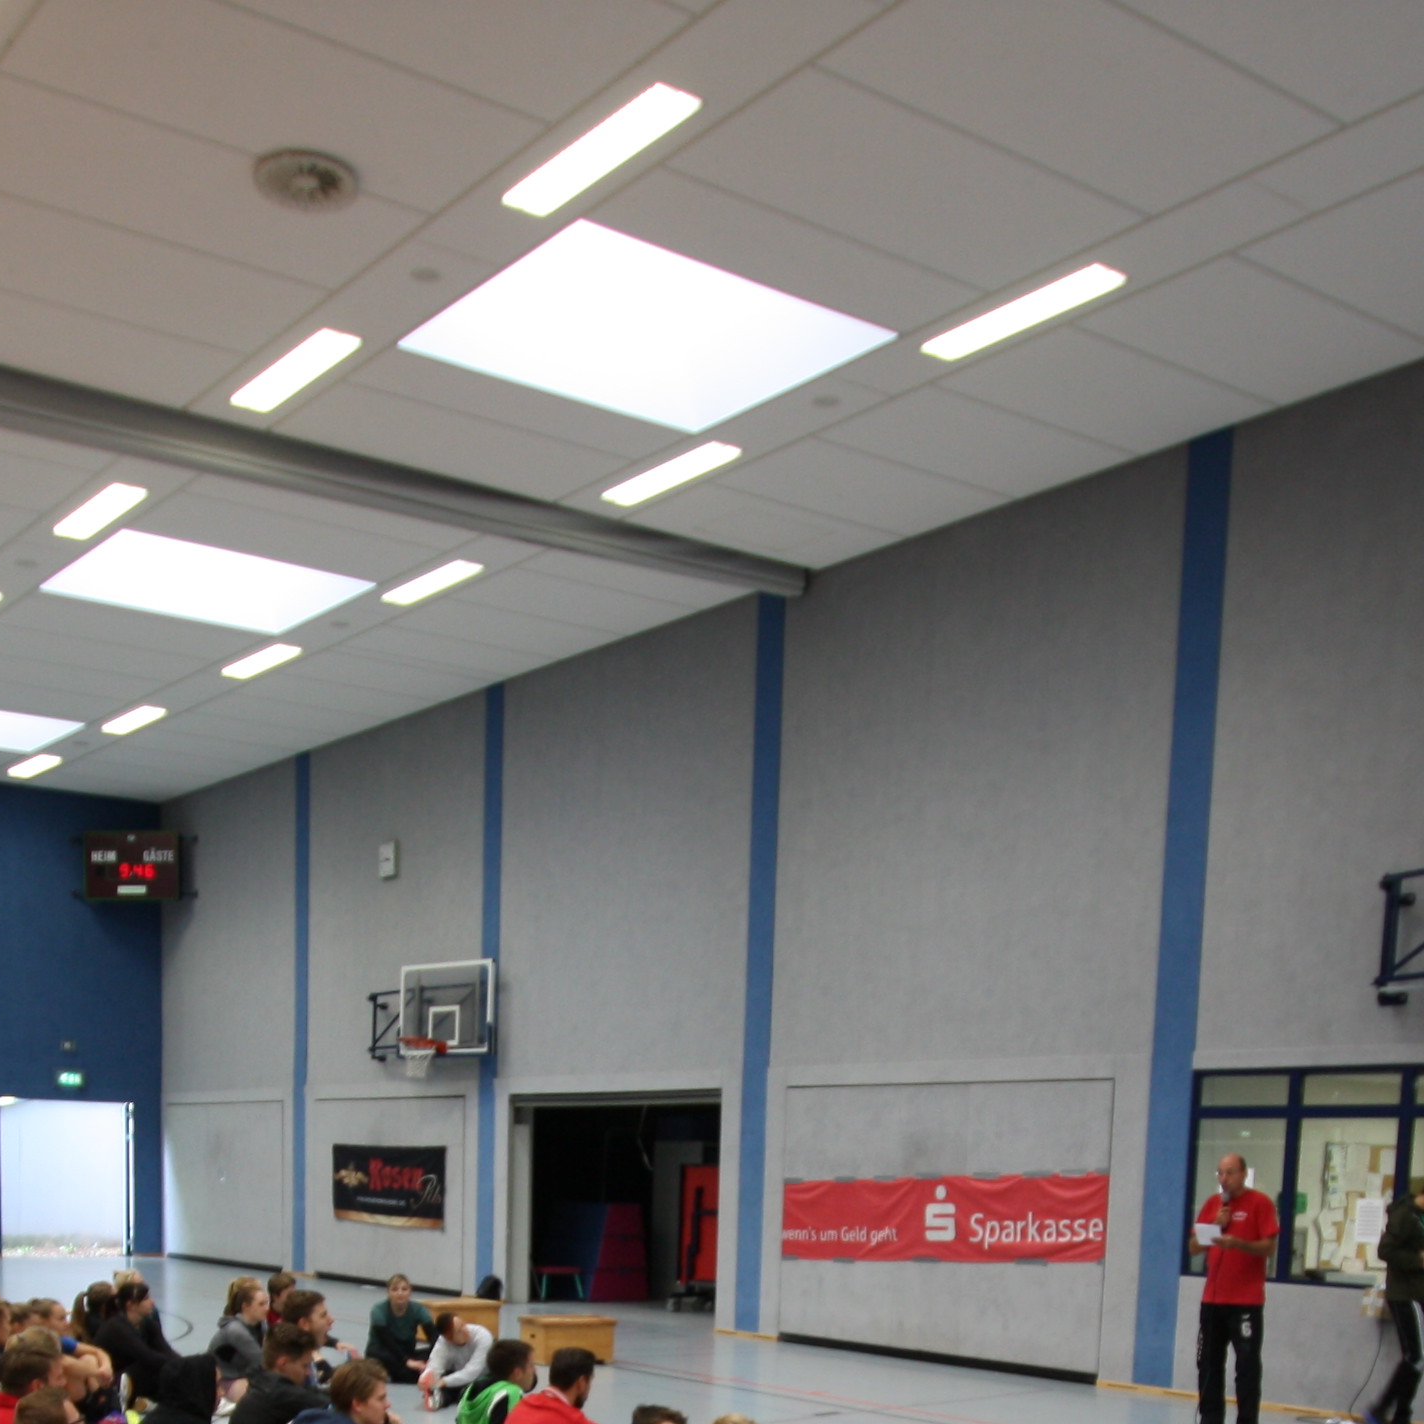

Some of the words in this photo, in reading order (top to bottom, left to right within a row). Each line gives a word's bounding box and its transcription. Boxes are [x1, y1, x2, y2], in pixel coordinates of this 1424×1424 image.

[91, 850, 117, 862] HEIM
[142, 847, 175, 862] GÄSTE
[820, 1230, 837, 1241] um
[841, 1226, 867, 1242] Geld
[871, 1226, 898, 1247] geht
[969, 1211, 1104, 1250] Sparkasse
